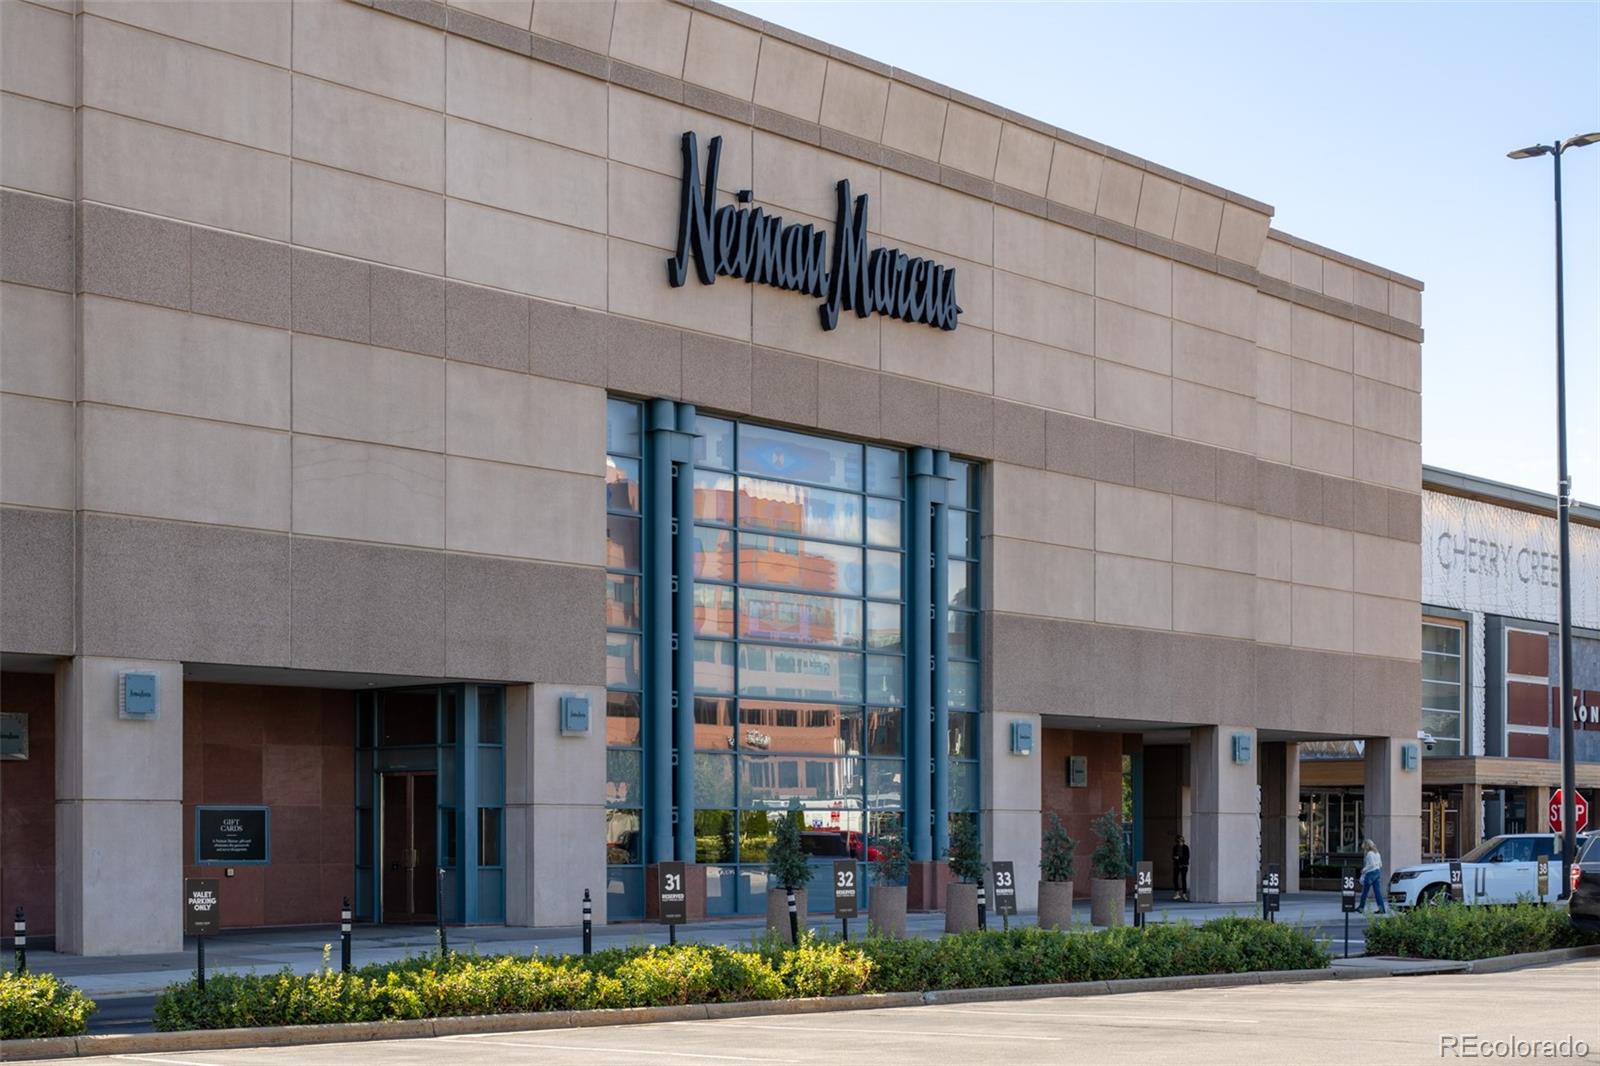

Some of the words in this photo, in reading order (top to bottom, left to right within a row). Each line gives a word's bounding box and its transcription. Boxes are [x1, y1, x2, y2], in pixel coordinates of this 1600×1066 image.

[667, 131, 831, 298] Neiman
[819, 178, 963, 331] Marcus
[1437, 531, 1511, 577] CHERRY
[1516, 547, 1559, 587] CREE
[1550, 804, 1585, 822] STP
[1451, 870, 1461, 882] 37
[1538, 863, 1547, 875] 38
[664, 873, 681, 891] 31
[836, 871, 854, 887] 32
[996, 871, 1012, 887] 33
[1138, 871, 1152, 886] 34
[1268, 872, 1279, 887] 35
[1343, 876, 1354, 889] 36
[188, 897, 217, 905] PARKING
